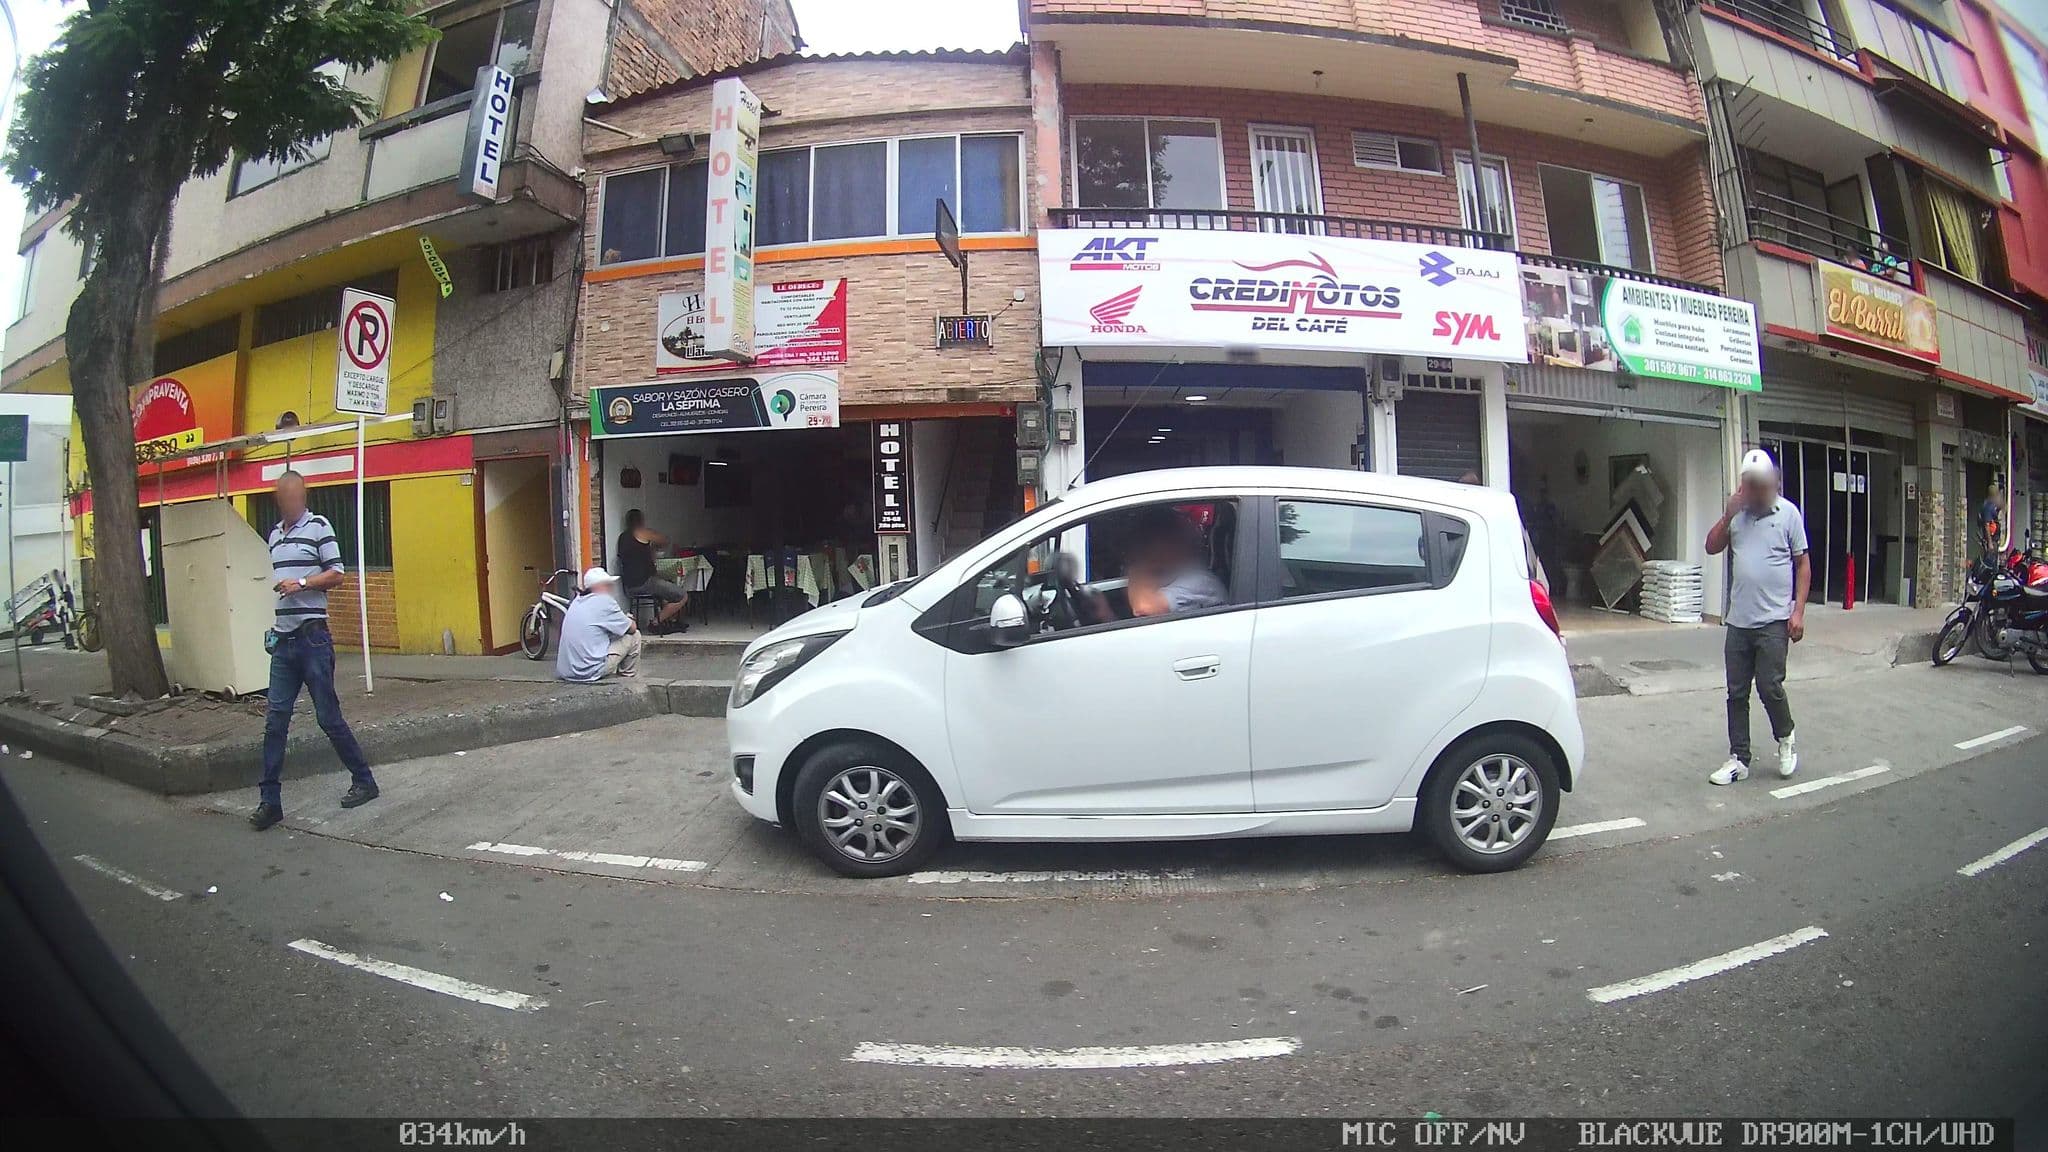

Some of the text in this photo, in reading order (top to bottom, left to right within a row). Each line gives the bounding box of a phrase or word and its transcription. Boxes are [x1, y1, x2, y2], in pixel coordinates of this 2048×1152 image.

[480, 71, 511, 184] HOTEL
[709, 106, 734, 325] HOTEL
[1071, 237, 1159, 261] AKT
[1122, 263, 1160, 271] MOTOS
[1456, 266, 1500, 279] BAJAJ
[1189, 277, 1401, 310] CREDIMOTOS
[1622, 286, 1749, 325] AMBIENTES Y MUEBLES PEREIRA
[1828, 288, 1904, 341] El Barril
[938, 320, 990, 339] ABIERTO
[1090, 325, 1147, 333] HONDA
[1252, 316, 1348, 333] DEL CAFÉ
[1432, 311, 1501, 345] SYM
[1643, 358, 1660, 373] 301
[632, 386, 750, 404] SABOR Y SAZÓN CASERO
[661, 401, 675, 412] LA
[880, 424, 900, 507] HOTEL
